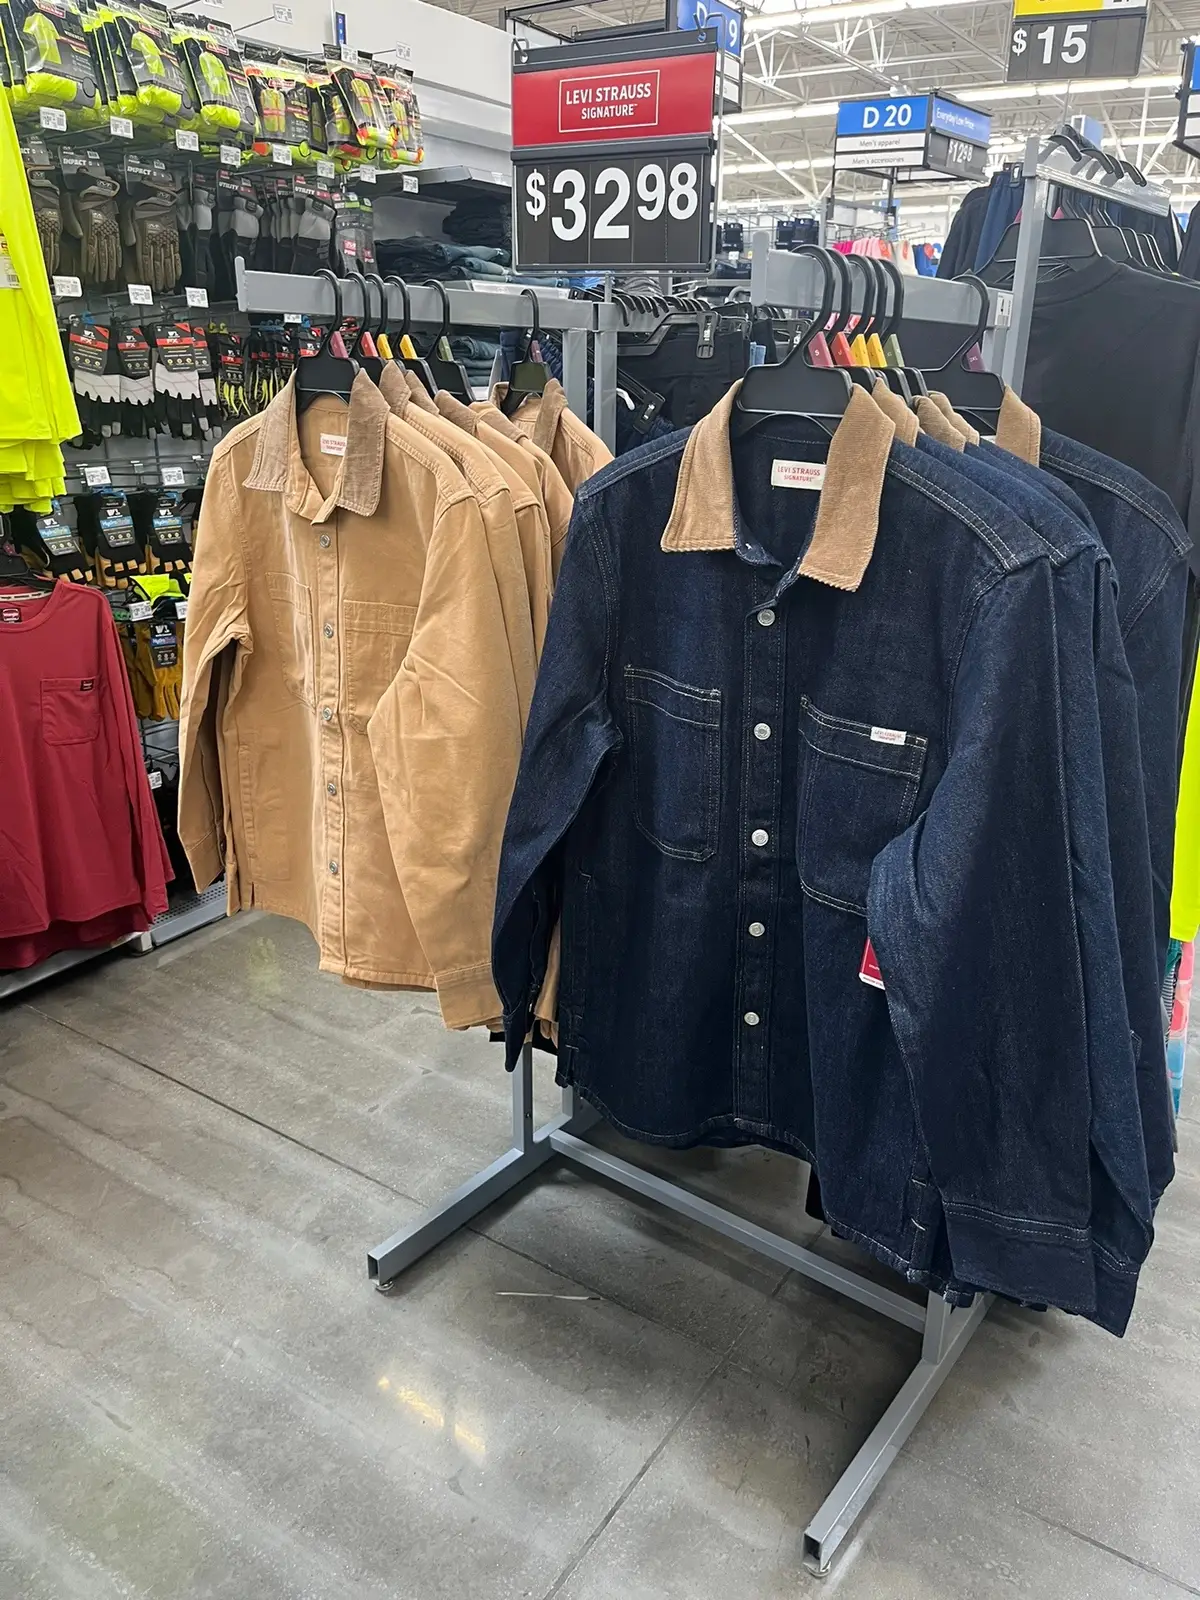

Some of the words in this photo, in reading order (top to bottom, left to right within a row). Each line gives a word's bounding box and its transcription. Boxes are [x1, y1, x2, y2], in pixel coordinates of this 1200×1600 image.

[566, 88, 592, 105] LEVI
[595, 83, 651, 102] STRAUSS
[862, 106, 880, 129] D
[884, 103, 912, 127] 20
[860, 139, 877, 147] Men's
[877, 138, 901, 148] apparel
[852, 157, 870, 165] Men's
[871, 156, 905, 165] accessories
[219, 182, 239, 190] UTILITY
[294, 185, 315, 195] UTILITY
[814, 349, 820, 357] S
[777, 466, 791, 474] LEVI
[792, 467, 821, 477] STRAUSS
